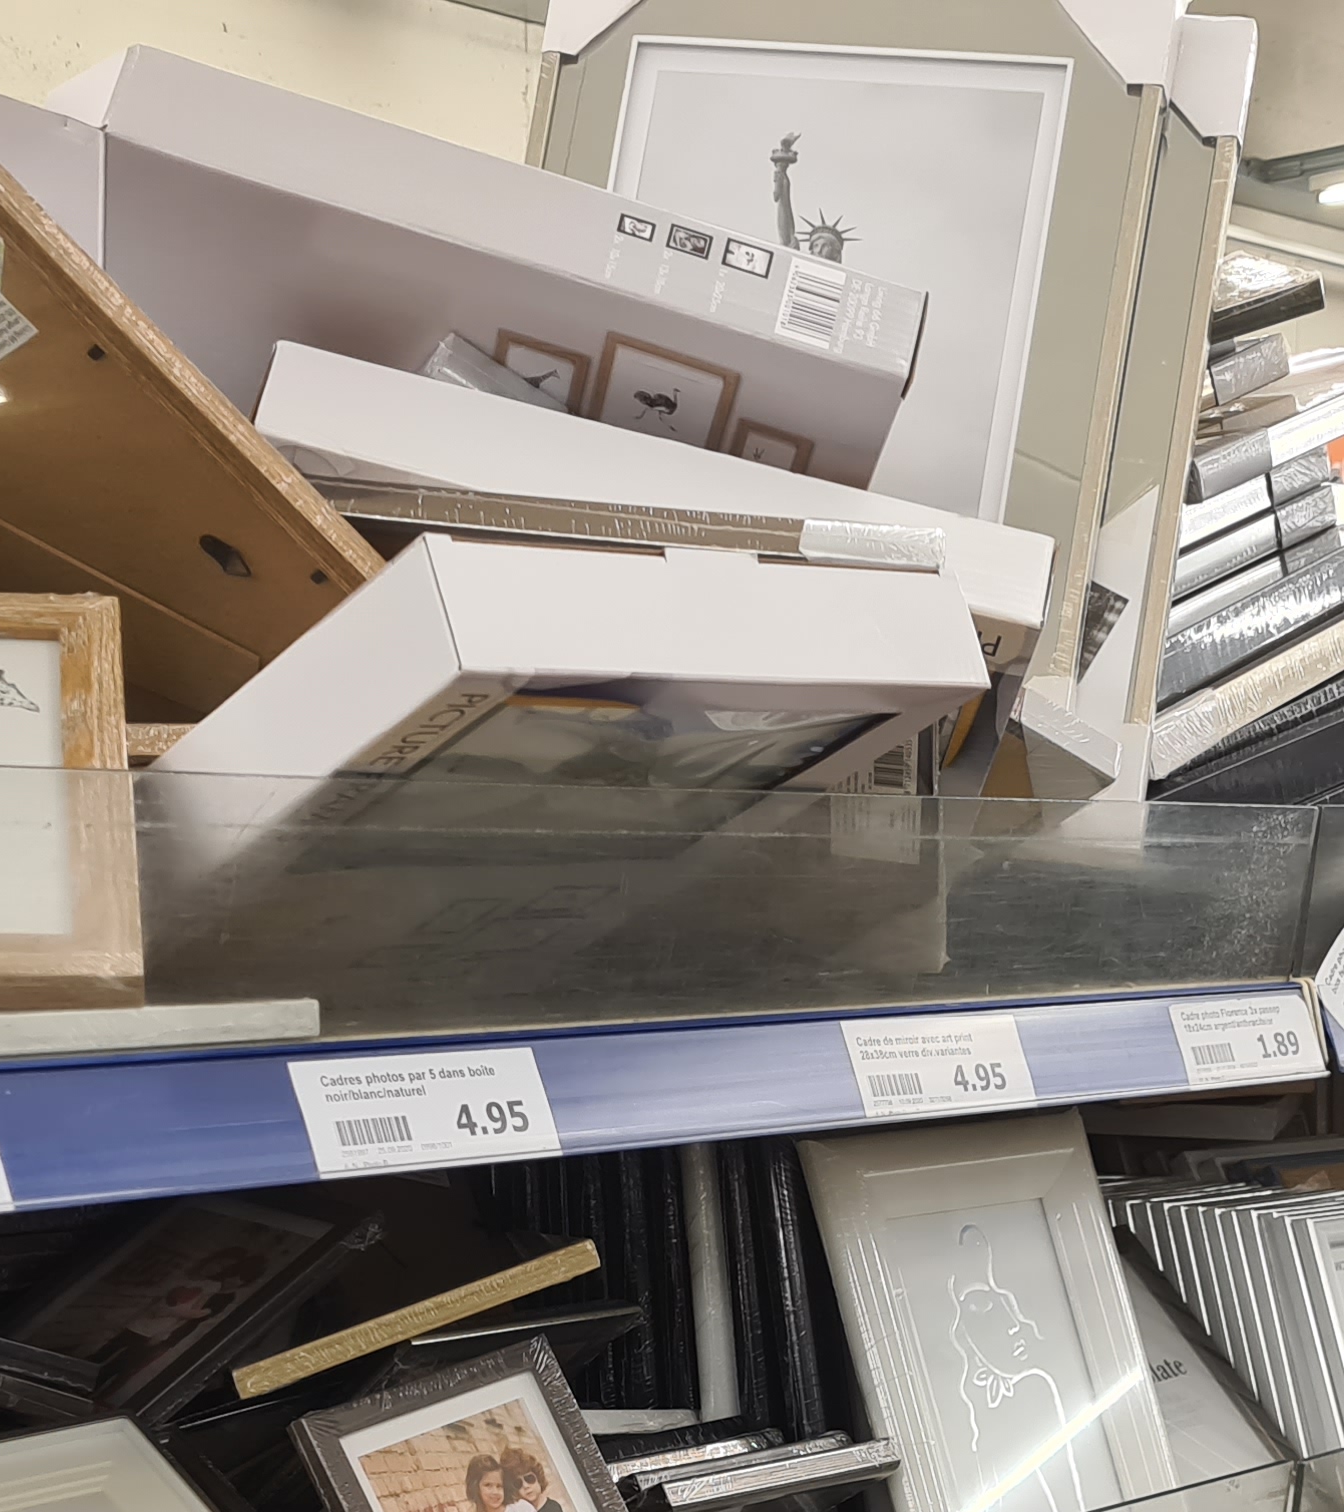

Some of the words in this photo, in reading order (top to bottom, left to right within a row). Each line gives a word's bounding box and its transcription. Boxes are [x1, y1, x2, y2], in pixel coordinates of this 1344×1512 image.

[368, 692, 490, 768] PICTURE
[1180, 1010, 1200, 1021] Cadre
[1201, 1009, 1220, 1020] photo
[855, 1036, 882, 1047] Cadre
[883, 1036, 894, 1046] de
[895, 1035, 920, 1045] miroir
[921, 1034, 941, 1044] avec
[941, 1033, 954, 1043] art
[953, 1032, 973, 1044] print
[1257, 1030, 1300, 1059] 1.89
[320, 1073, 362, 1087] Cadres
[365, 1071, 406, 1087] photos
[407, 1070, 426, 1084] par
[429, 1068, 437, 1080] 5
[438, 1067, 466, 1080] dans
[953, 1062, 1007, 1093] 4.95
[325, 1085, 427, 1103] noir/blanc/naturel
[456, 1099, 530, 1136] 4.95
[1149, 1359, 1187, 1383] late
